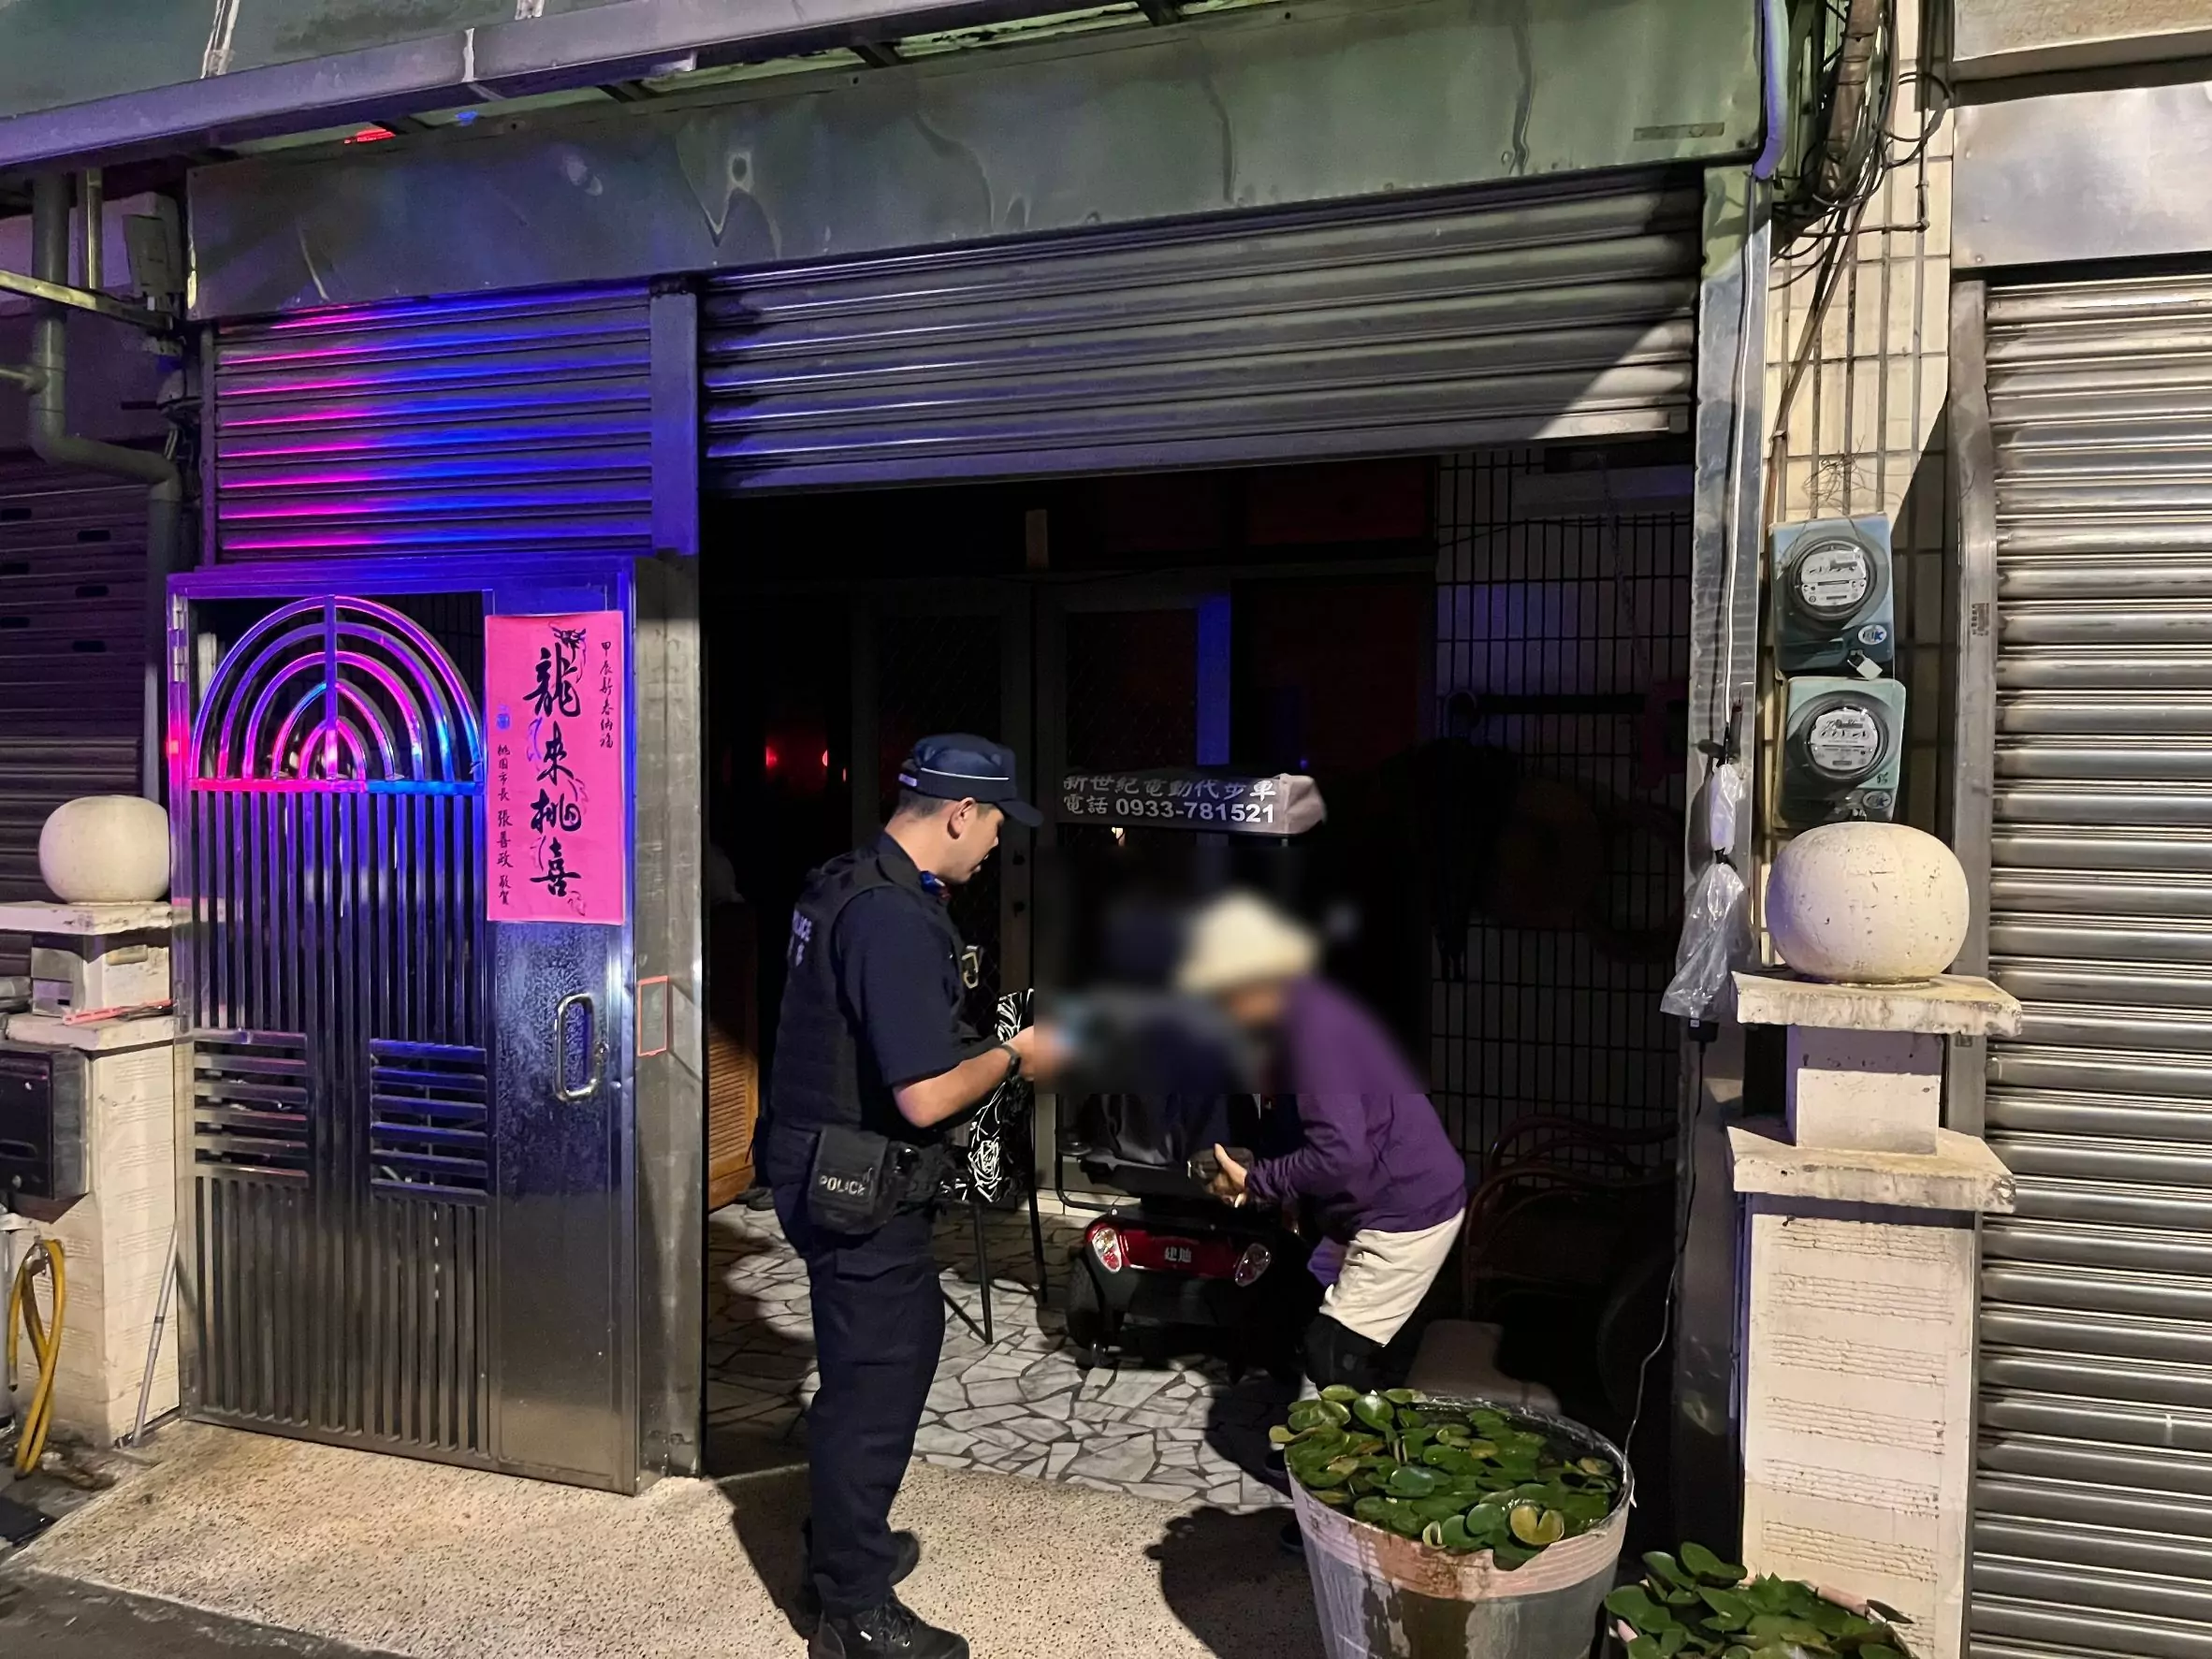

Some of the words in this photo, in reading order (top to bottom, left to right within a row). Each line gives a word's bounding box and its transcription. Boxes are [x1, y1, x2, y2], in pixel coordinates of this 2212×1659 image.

[1063, 775, 1276, 802] 新世紀電動代步車
[1063, 795, 1109, 815] 電話
[1115, 798, 1274, 823] 0933-781521
[496, 809, 513, 868] 張善政
[819, 1175, 866, 1196] POLICE
